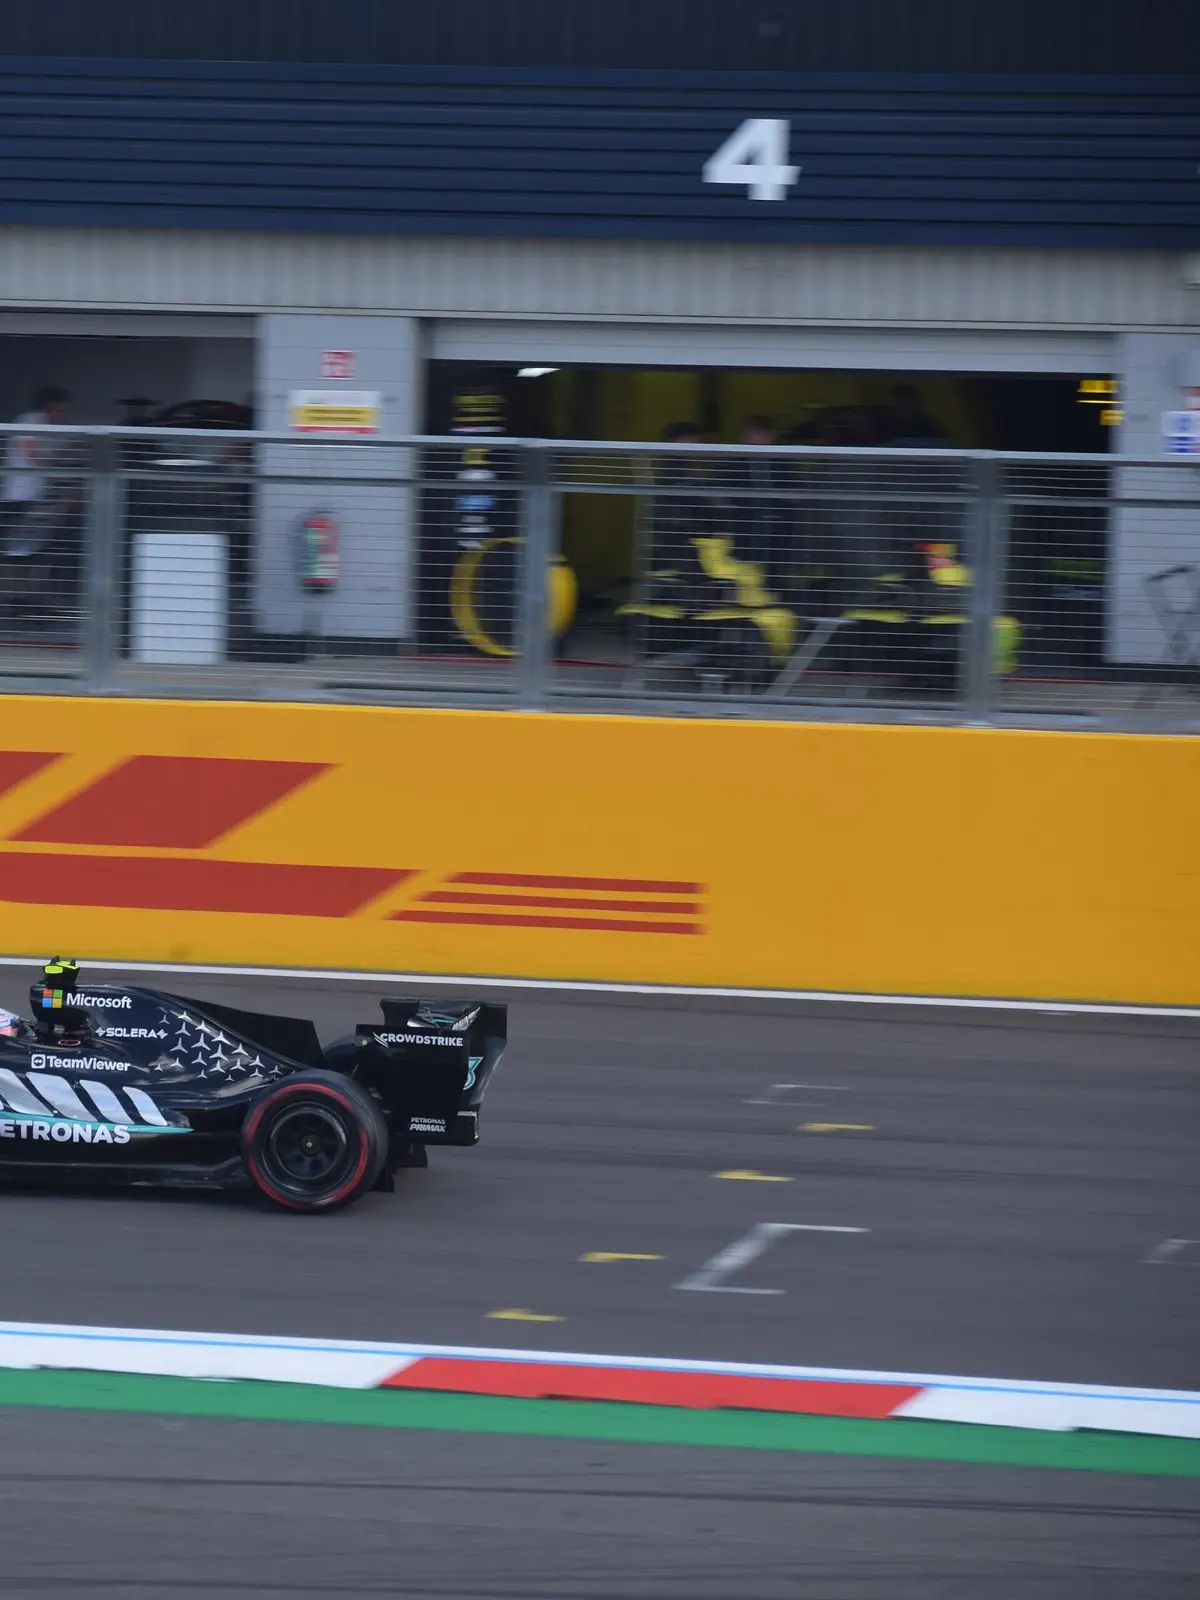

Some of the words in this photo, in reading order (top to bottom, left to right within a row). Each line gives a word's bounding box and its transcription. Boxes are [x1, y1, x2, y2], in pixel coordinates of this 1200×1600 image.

[701, 118, 802, 200] 4
[66, 993, 132, 1009] Microsoft
[105, 1027, 158, 1039] SOLERA
[380, 1033, 463, 1047] CROWDSTRIKE
[46, 1055, 131, 1071] TeamViewer
